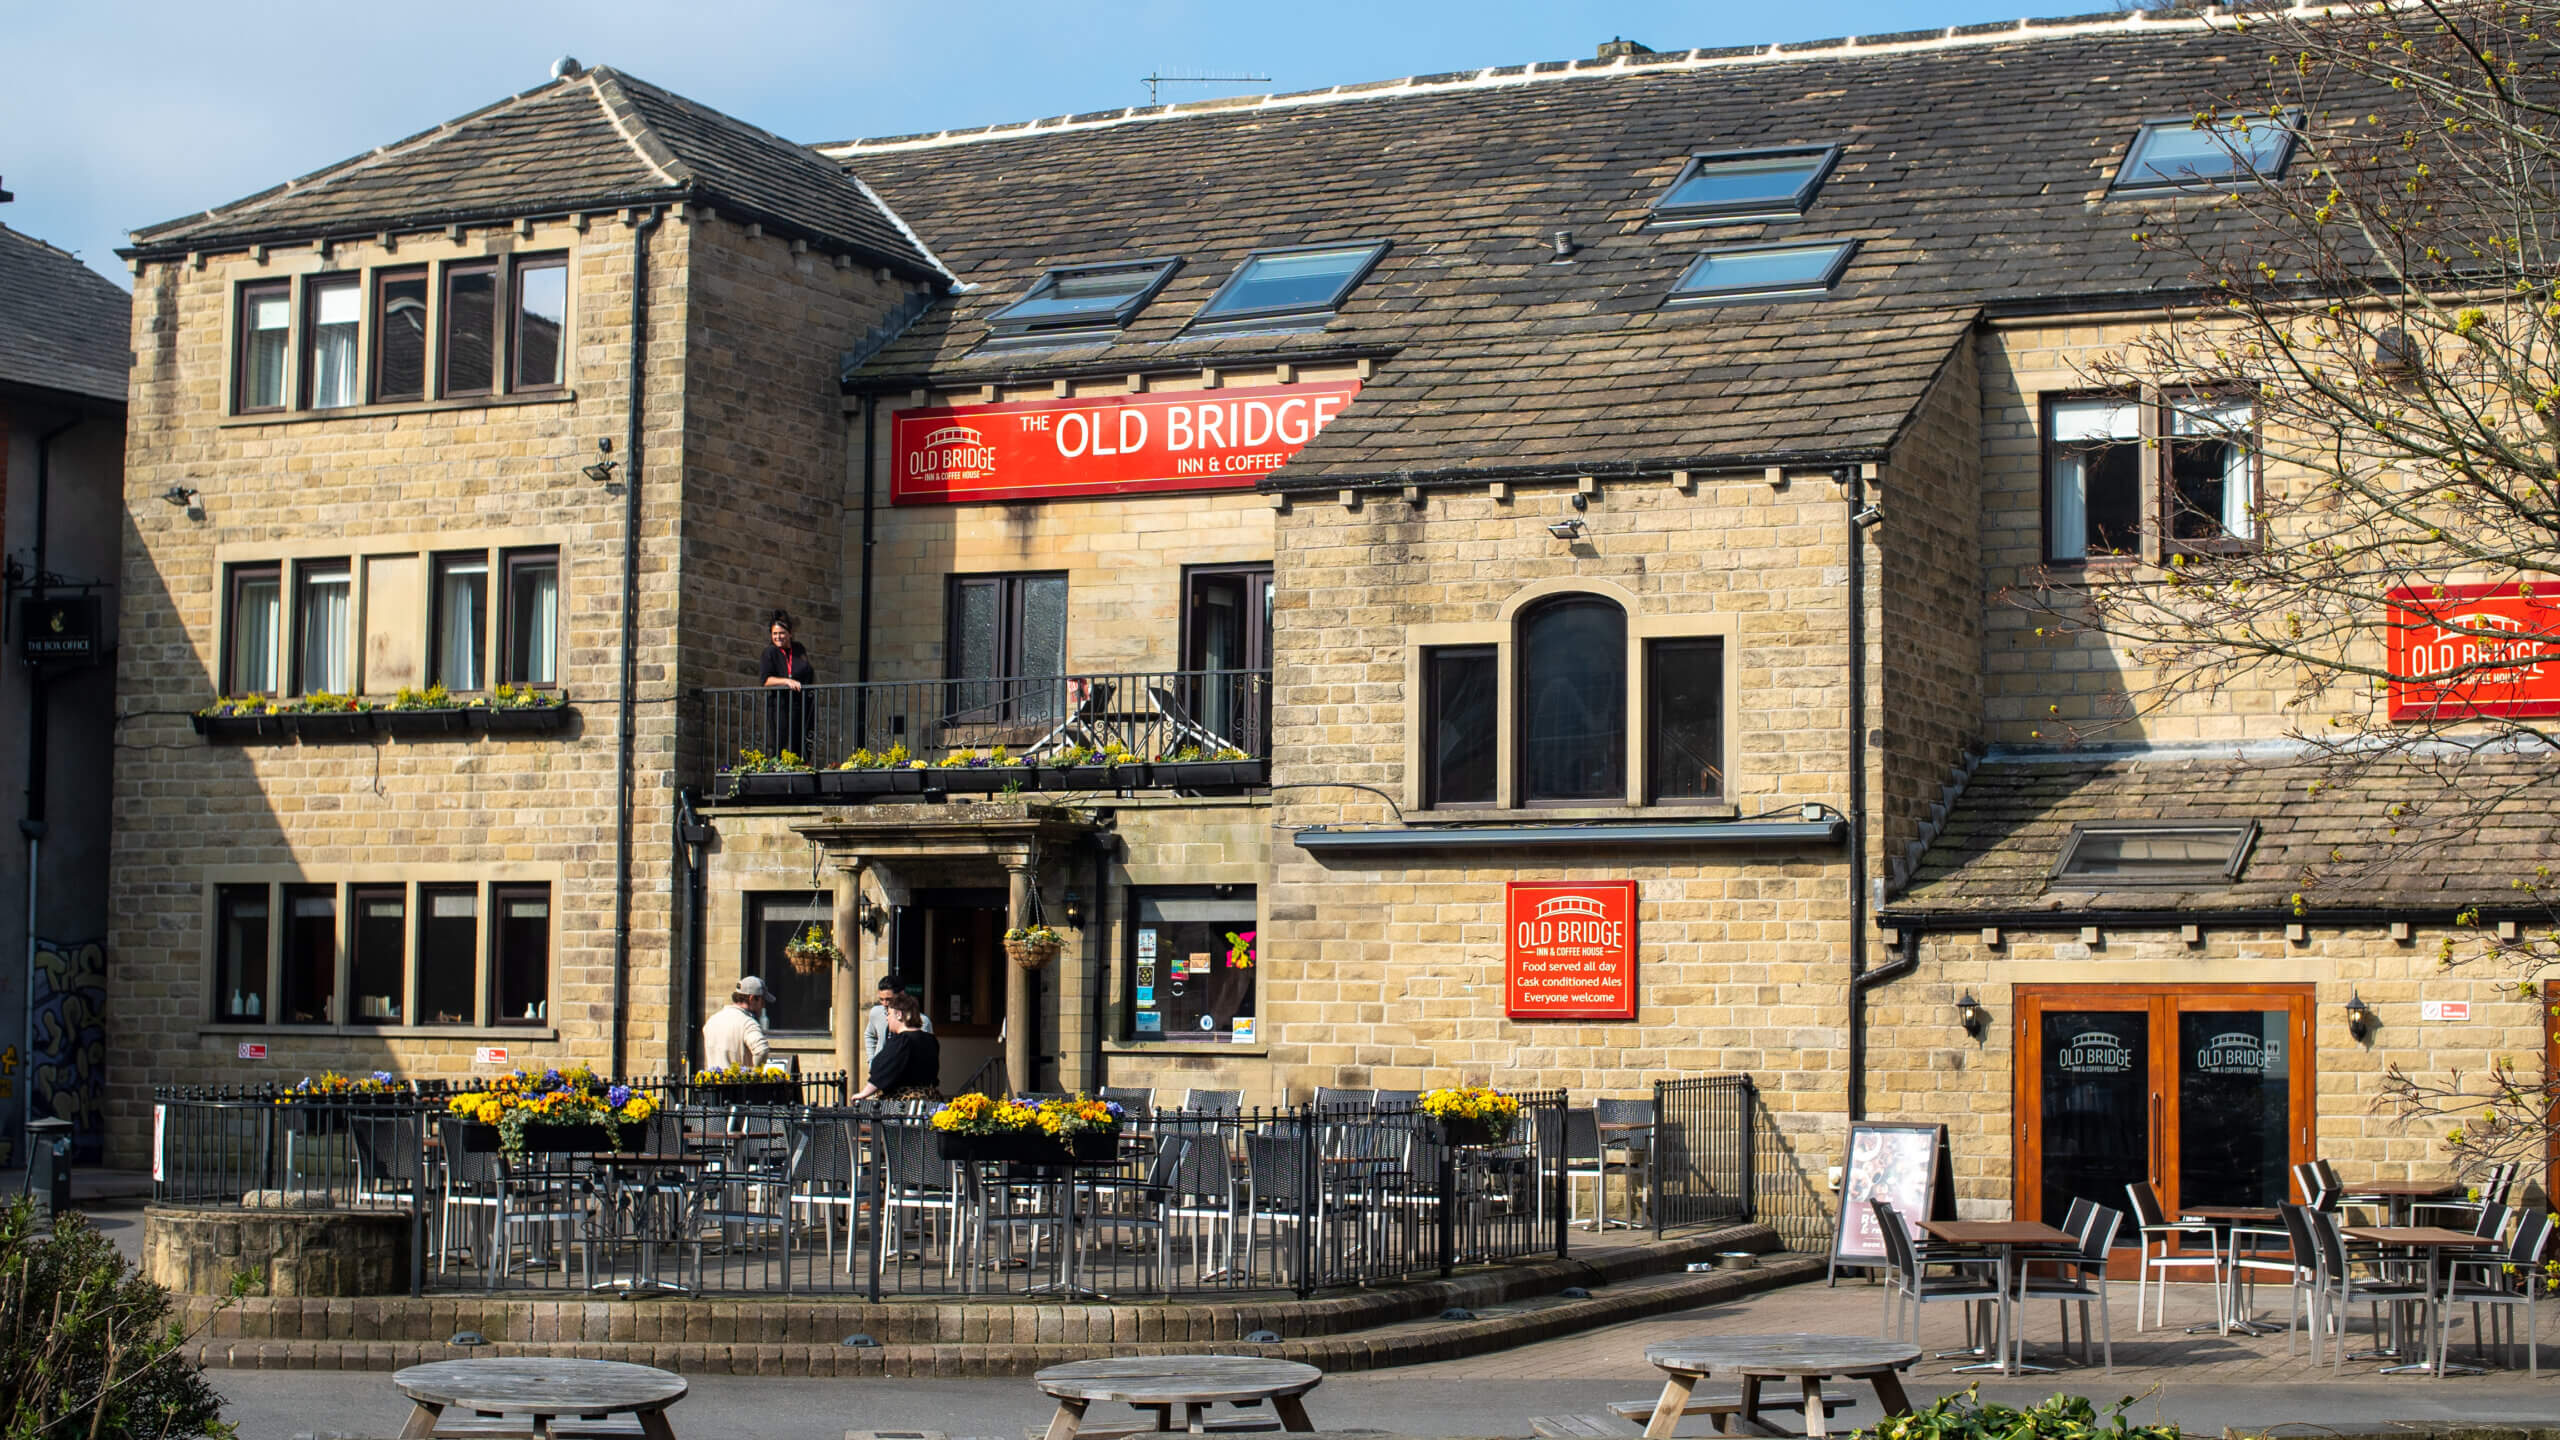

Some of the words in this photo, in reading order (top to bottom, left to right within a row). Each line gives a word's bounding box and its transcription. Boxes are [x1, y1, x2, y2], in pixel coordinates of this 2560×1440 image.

[1020, 415, 1050, 432] THE
[1055, 409, 1148, 458] OLD
[1167, 396, 1341, 451] BRIDGE
[909, 450, 938, 475] OLD
[942, 447, 996, 471] BRIDGE
[1177, 457, 1203, 473] INN
[1208, 456, 1220, 472] &
[1225, 453, 1283, 471] COFFEE
[924, 472, 935, 481] INN
[941, 471, 961, 480] COFFEE
[962, 470, 981, 479] HOUSE
[62, 640, 89, 650] OFFICE
[2412, 644, 2454, 677] OLD
[1518, 921, 1552, 948] OLD
[1558, 920, 1623, 948] BRIDGE
[1536, 947, 1549, 956] INN
[1549, 947, 1555, 956] &
[1556, 947, 1581, 956] COFFEE
[1582, 947, 1604, 956] HOUSE
[1522, 961, 1546, 971] Food
[1549, 961, 1581, 971] served
[1584, 961, 1596, 971] all
[1599, 961, 1616, 973] day
[1517, 976, 1539, 986] Cask
[1542, 976, 1599, 986] conditioned
[1601, 976, 1622, 986] Ales
[1524, 992, 1568, 1004] Everyone
[1571, 992, 1615, 1002] welcome
[2060, 1048, 2084, 1067] OLD
[2087, 1048, 2132, 1068] BRIDGE
[2198, 1049, 2222, 1068] OLD
